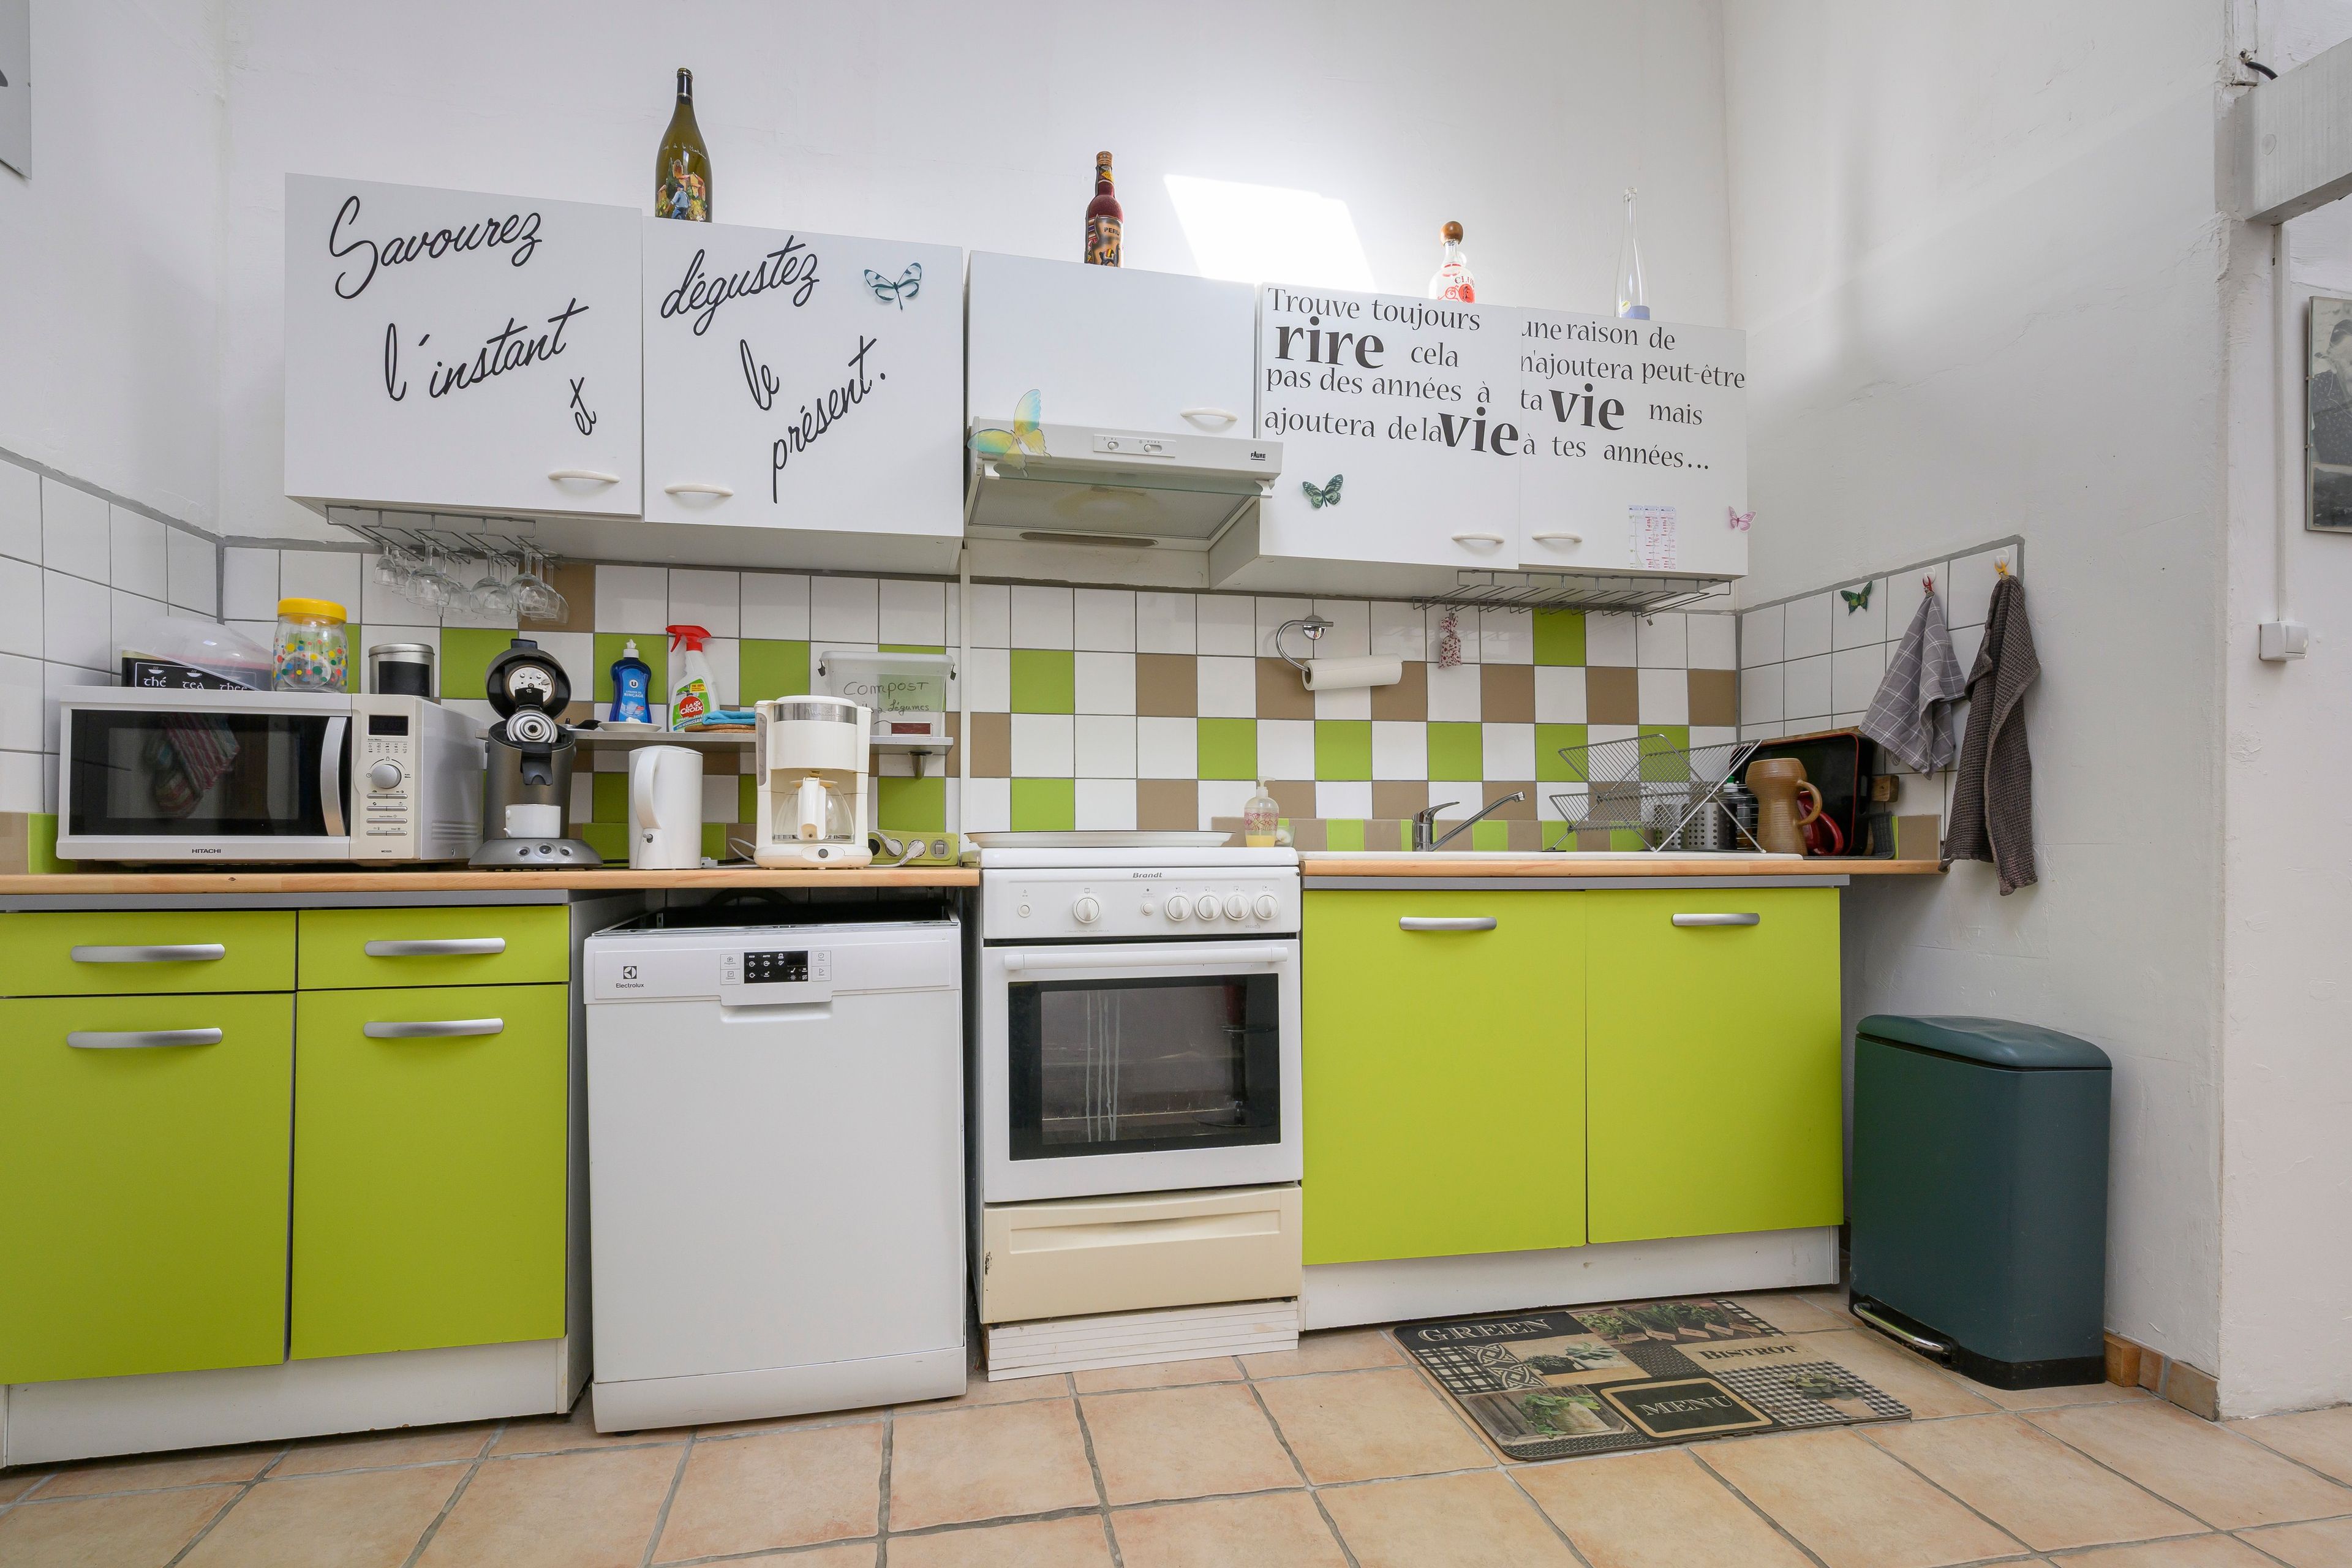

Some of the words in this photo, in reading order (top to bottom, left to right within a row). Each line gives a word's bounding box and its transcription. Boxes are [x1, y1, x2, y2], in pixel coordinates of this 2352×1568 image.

[329, 195, 542, 300] Savourez
[1104, 227, 1120, 236] PERU
[661, 235, 820, 336] dégustez
[385, 298, 590, 401] l'instant
[1267, 287, 1360, 319] Trouve
[1371, 299, 1480, 331] toujours
[1566, 321, 1638, 346] raison
[1649, 326, 1676, 350] de
[740, 339, 780, 410] le
[1275, 315, 1385, 369] rire
[1411, 342, 1459, 368] cela
[1521, 350, 1634, 380] n'ajoutera
[1642, 361, 1746, 389] peut-être
[570, 377, 597, 435] et
[773, 335, 886, 504] présent.
[1266, 368, 1311, 392] pas
[1320, 368, 1363, 394] des
[1372, 377, 1462, 402] années
[1477, 381, 1491, 404] à
[1521, 388, 1543, 411] ta
[1549, 383, 1625, 431] vie
[1649, 403, 1703, 425] mais
[1265, 407, 1376, 438] ajoutera
[1388, 415, 1418, 440] de
[1421, 417, 1443, 442] la
[1438, 407, 1519, 456] vie
[1523, 433, 1536, 455] à
[1552, 435, 1586, 458] tes
[1604, 445, 1709, 470] années...
[144, 676, 167, 687] thé
[183, 680, 205, 690] tea
[680, 706, 703, 715] CROIX
[1418, 1319, 1553, 1341] GREEN
[1635, 1395, 1733, 1416] MENU
